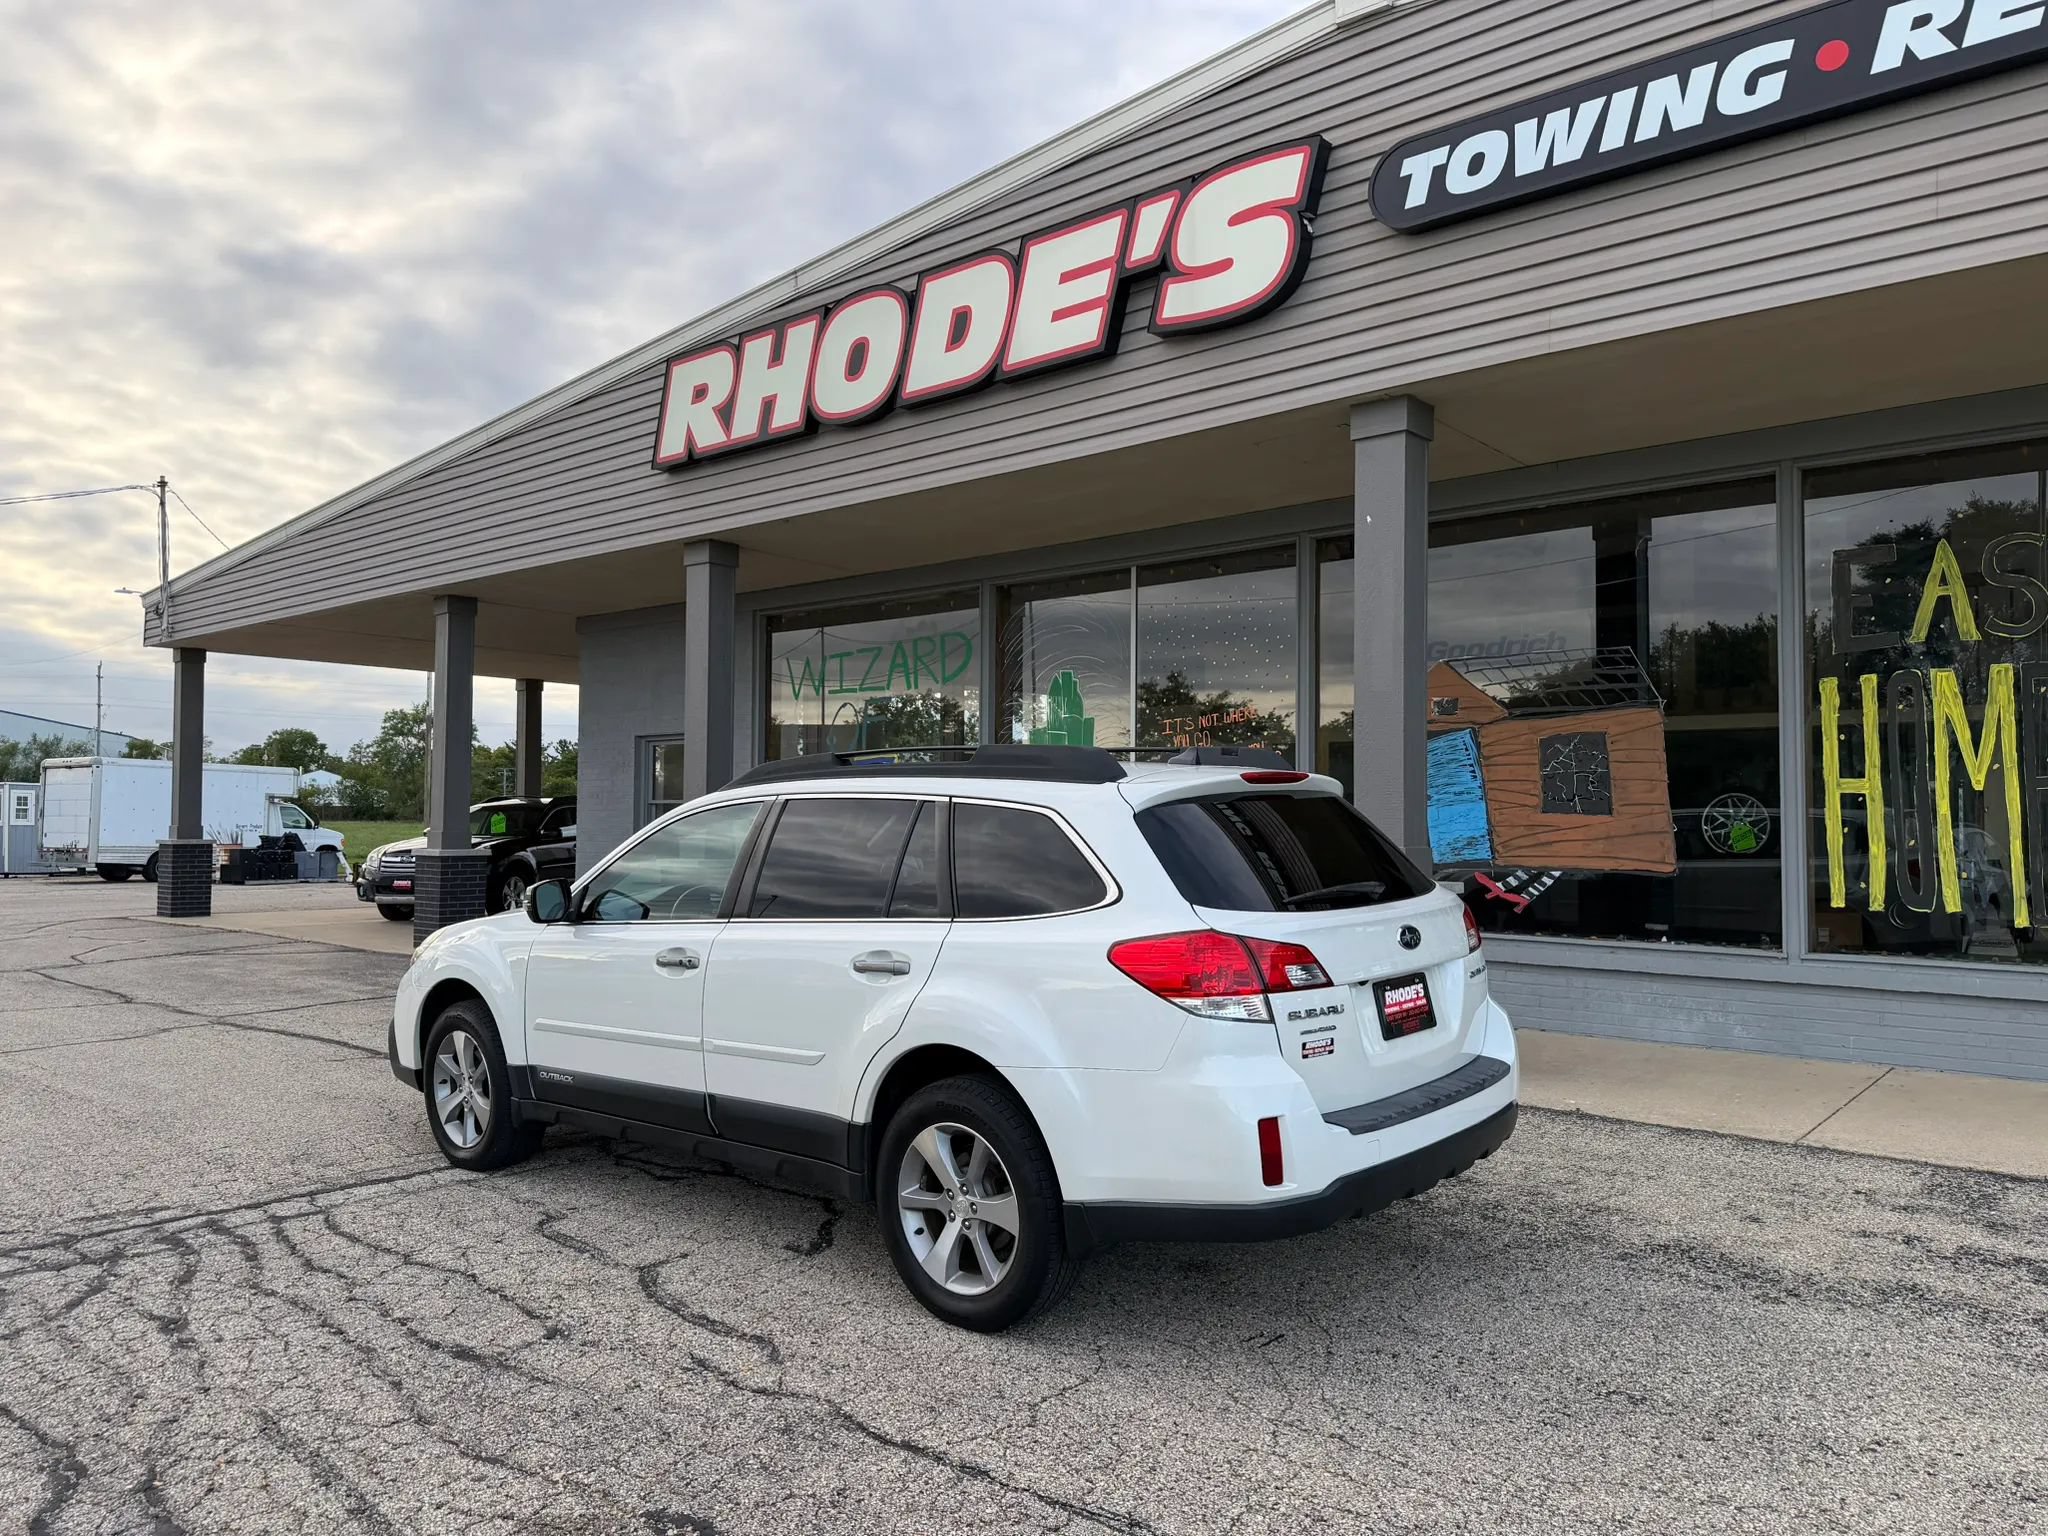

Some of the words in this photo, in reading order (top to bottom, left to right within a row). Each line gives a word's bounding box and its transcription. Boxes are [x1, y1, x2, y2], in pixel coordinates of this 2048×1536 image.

[1401, 38, 1795, 211] TOWING
[1870, 0, 2046, 75] RE
[655, 144, 1312, 465] RHODE'S
[1832, 532, 2048, 653] EAS
[786, 631, 973, 701] WIZARD
[1162, 716, 1195, 735] IT'S
[1199, 713, 1219, 729] NOT
[1223, 704, 1259, 724] WHERE
[1287, 1004, 1345, 1022] SUBARU
[1384, 983, 1425, 1005] RHODE'S
[540, 1071, 574, 1083] OUTBACK
